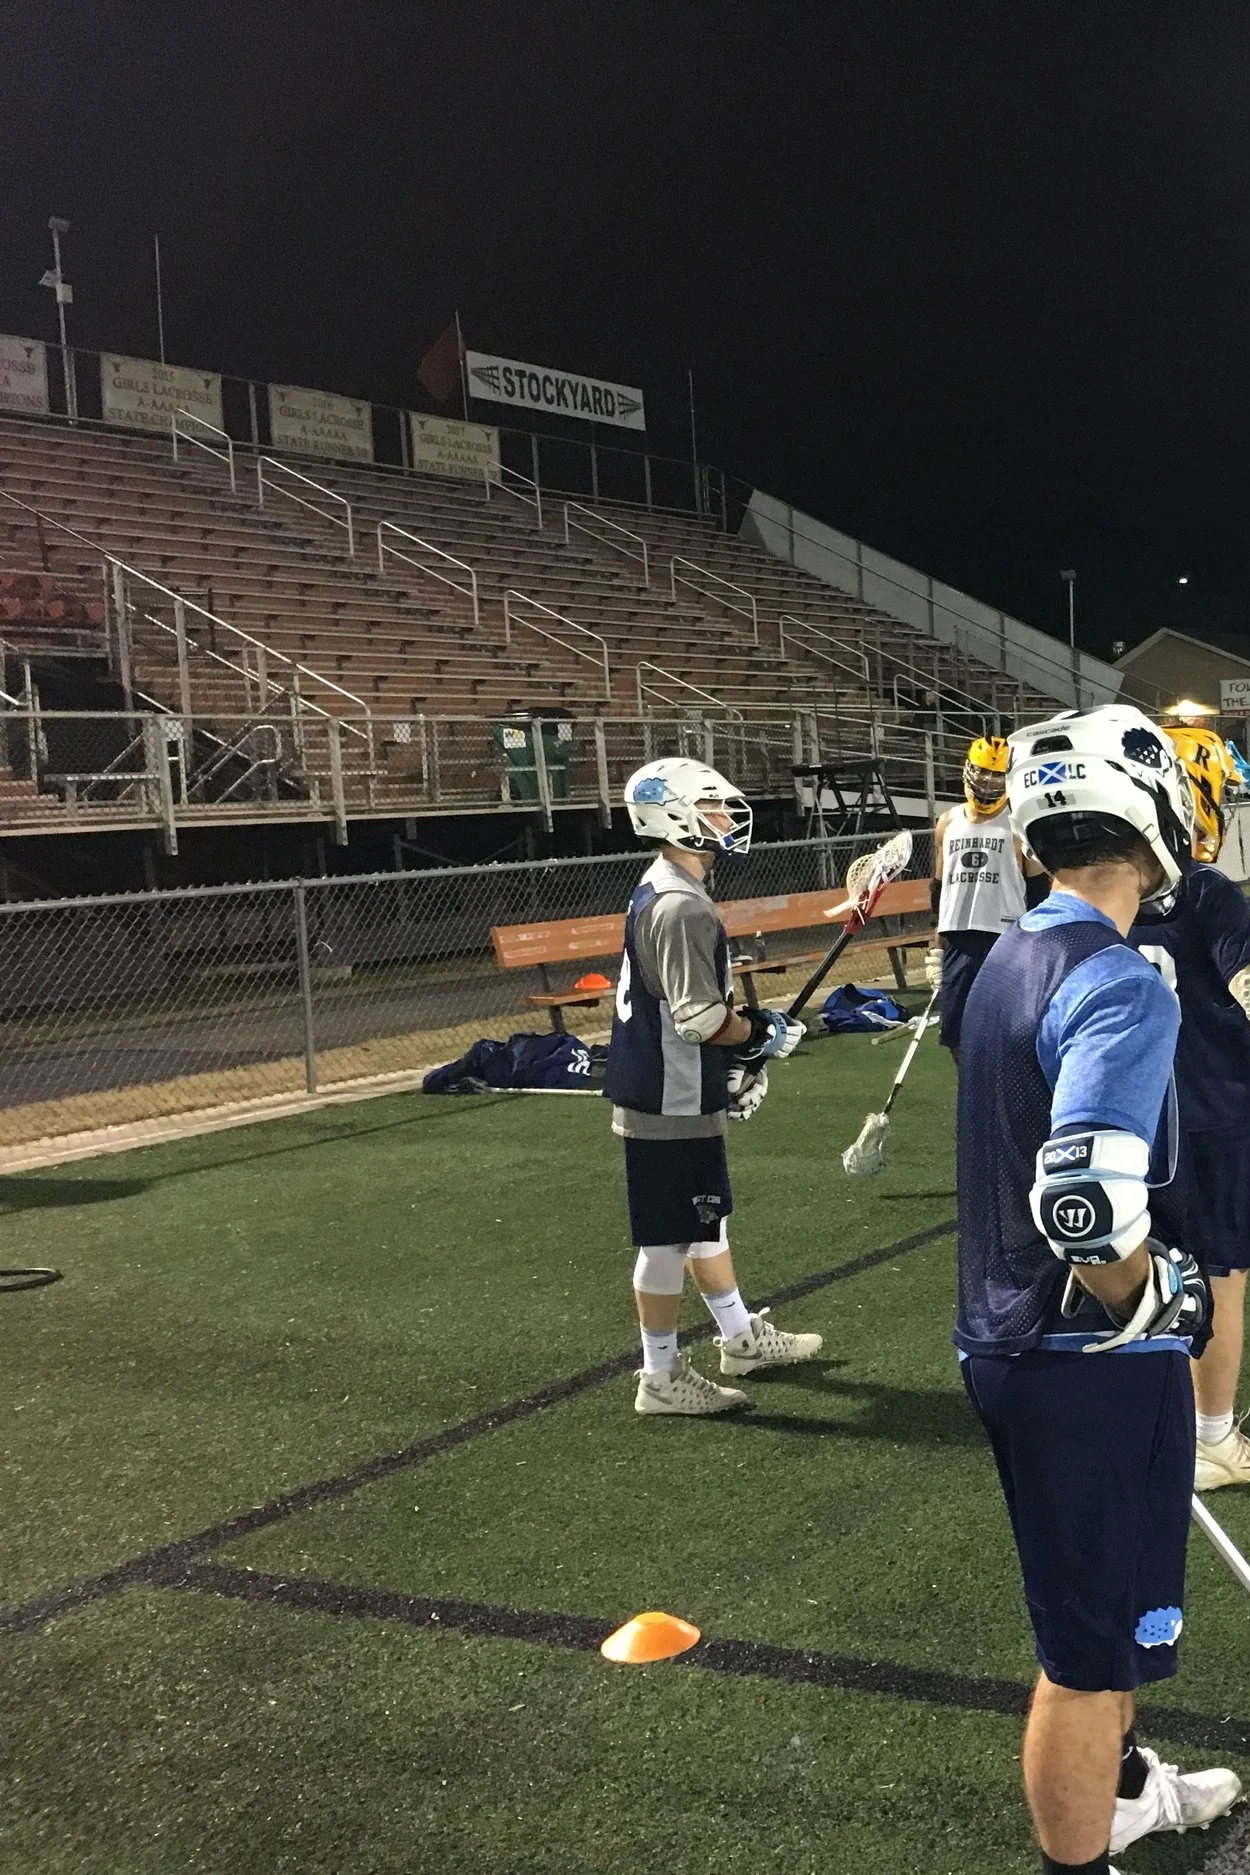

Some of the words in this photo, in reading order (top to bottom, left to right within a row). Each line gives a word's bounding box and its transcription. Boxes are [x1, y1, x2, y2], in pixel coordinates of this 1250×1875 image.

[112, 376, 150, 394] GIRLS
[152, 383, 213, 406] LACROSSE
[502, 366, 616, 418] STOCKYARD
[108, 407, 149, 424] STATE
[151, 412, 214, 435] CHMPIO
[279, 405, 312, 420] GIRLS
[313, 411, 365, 431] LACROSSE
[277, 434, 310, 449] STATE
[419, 432, 448, 447] GIRLS
[447, 438, 493, 454] LACROSSE
[1222, 696, 1250, 707] THE
[1026, 725, 1071, 737] cascade
[1023, 770, 1038, 789] EC
[1068, 763, 1087, 780] LC
[1044, 790, 1067, 808] 14
[949, 837, 1005, 857] REINHARDT
[971, 853, 980, 867] 6
[949, 871, 1000, 885] LACROSSE
